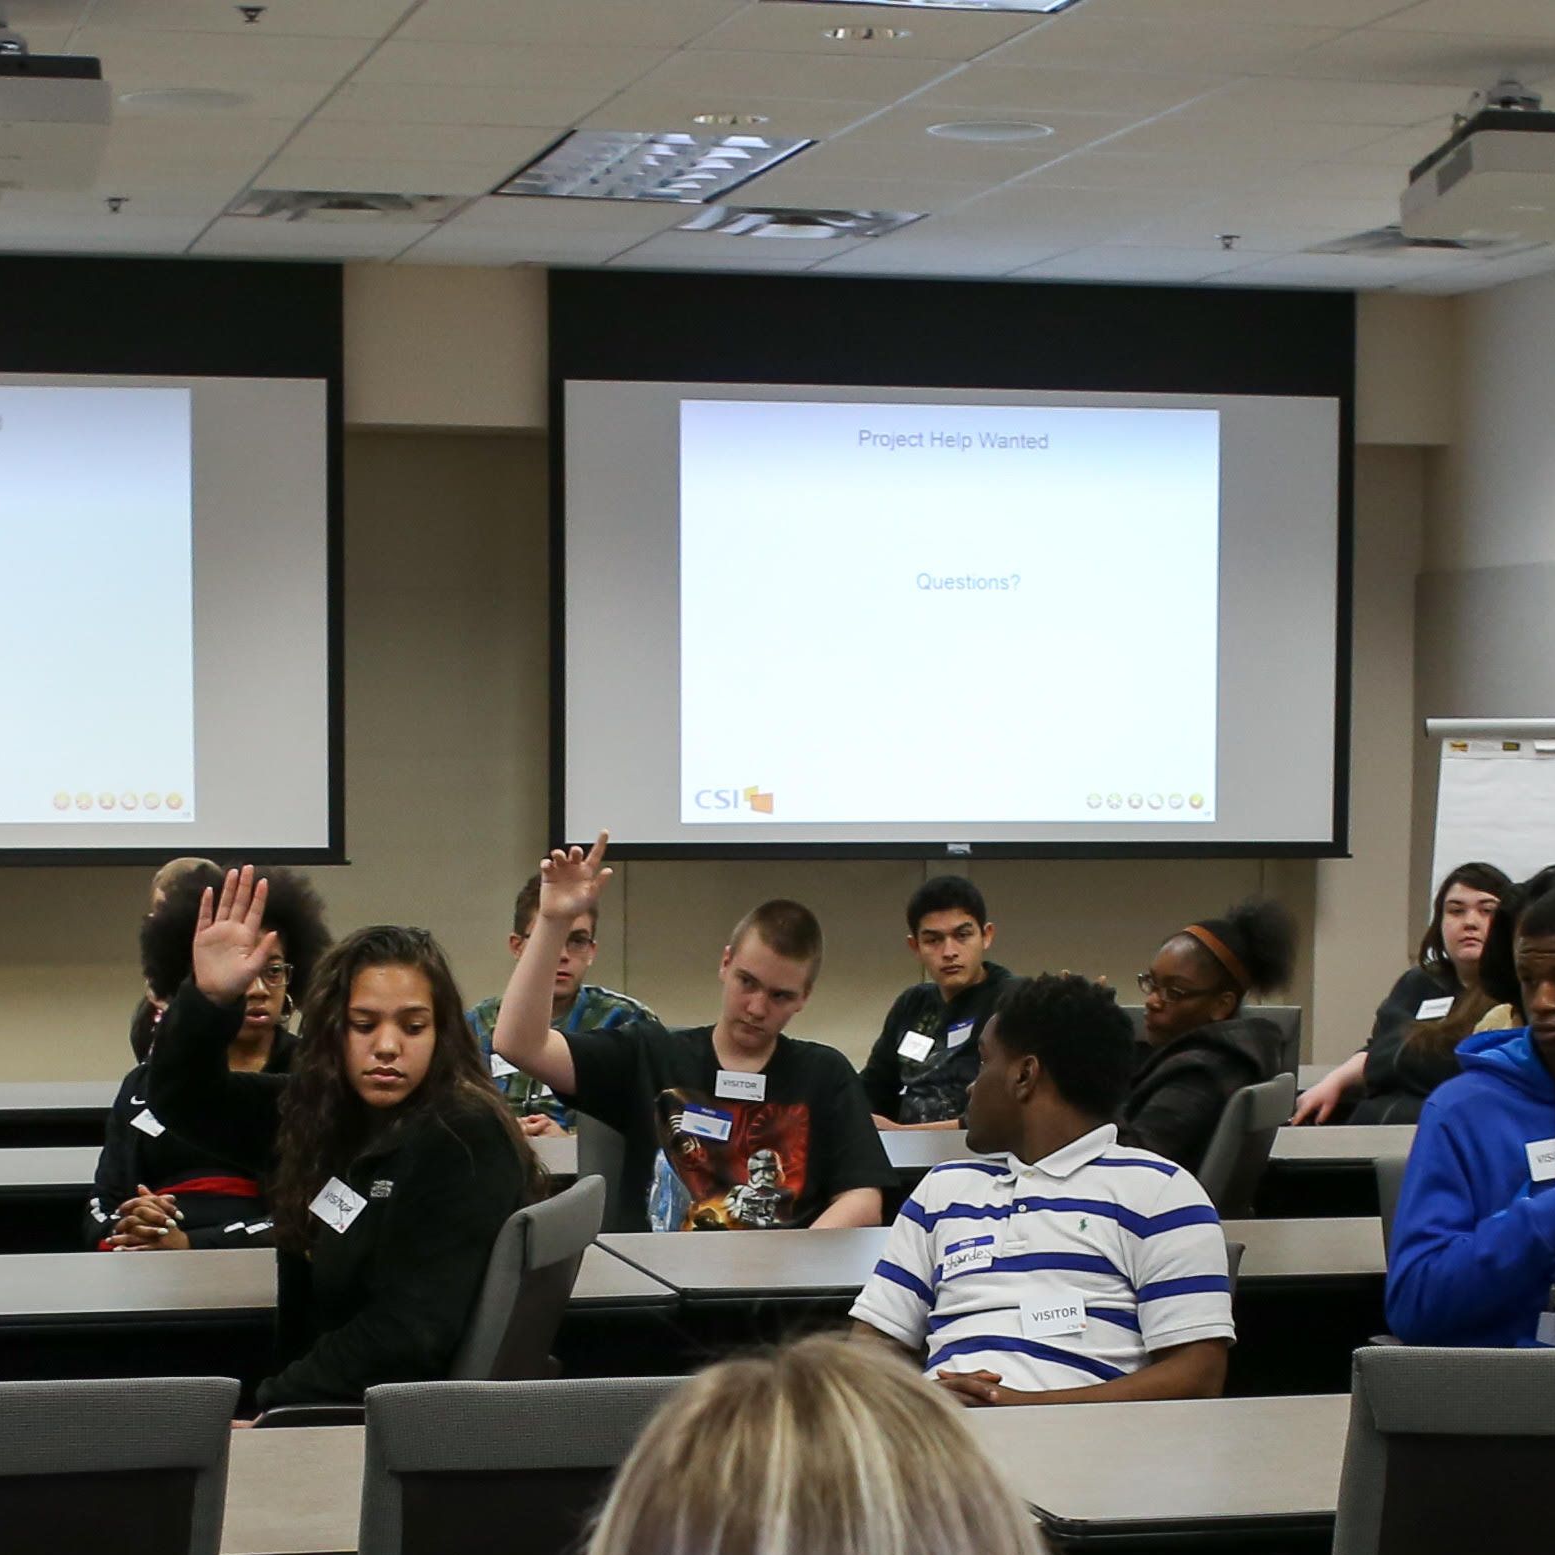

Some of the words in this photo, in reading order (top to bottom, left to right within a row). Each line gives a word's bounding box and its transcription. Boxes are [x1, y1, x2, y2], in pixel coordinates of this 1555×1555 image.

[858, 429, 925, 452] Project
[929, 431, 974, 452] Help
[978, 432, 1050, 450] Wanted
[916, 572, 1022, 591] Questions?
[695, 789, 739, 810] CSI
[723, 1080, 758, 1089] VISITOR
[1032, 1307, 1078, 1322] VISITOR
